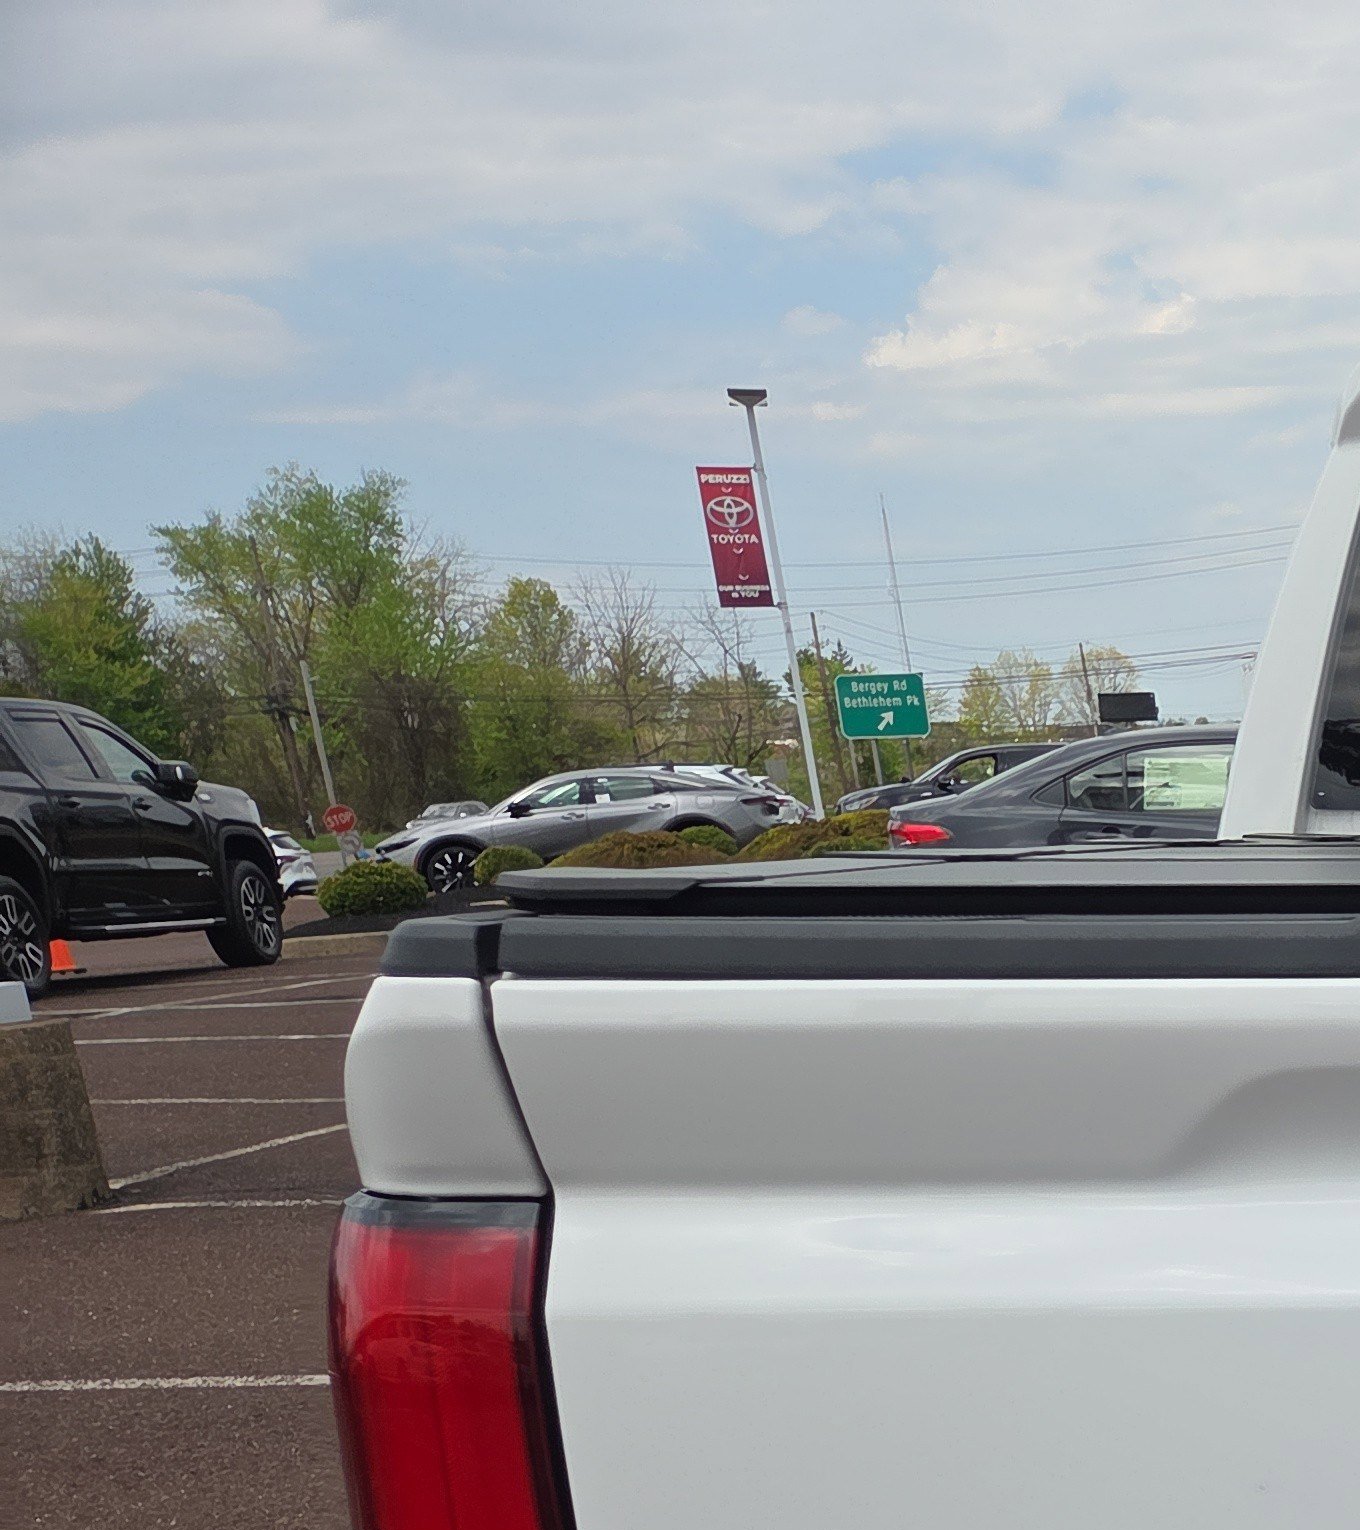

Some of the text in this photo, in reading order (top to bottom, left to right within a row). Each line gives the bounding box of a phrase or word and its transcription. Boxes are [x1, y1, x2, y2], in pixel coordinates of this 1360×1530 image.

[700, 473, 750, 485] PERUZZI
[711, 533, 759, 545] TOYOTA
[850, 678, 907, 694] Bergey Rd
[844, 694, 920, 709] Bethlehem Pk
[326, 811, 351, 828] STOP
